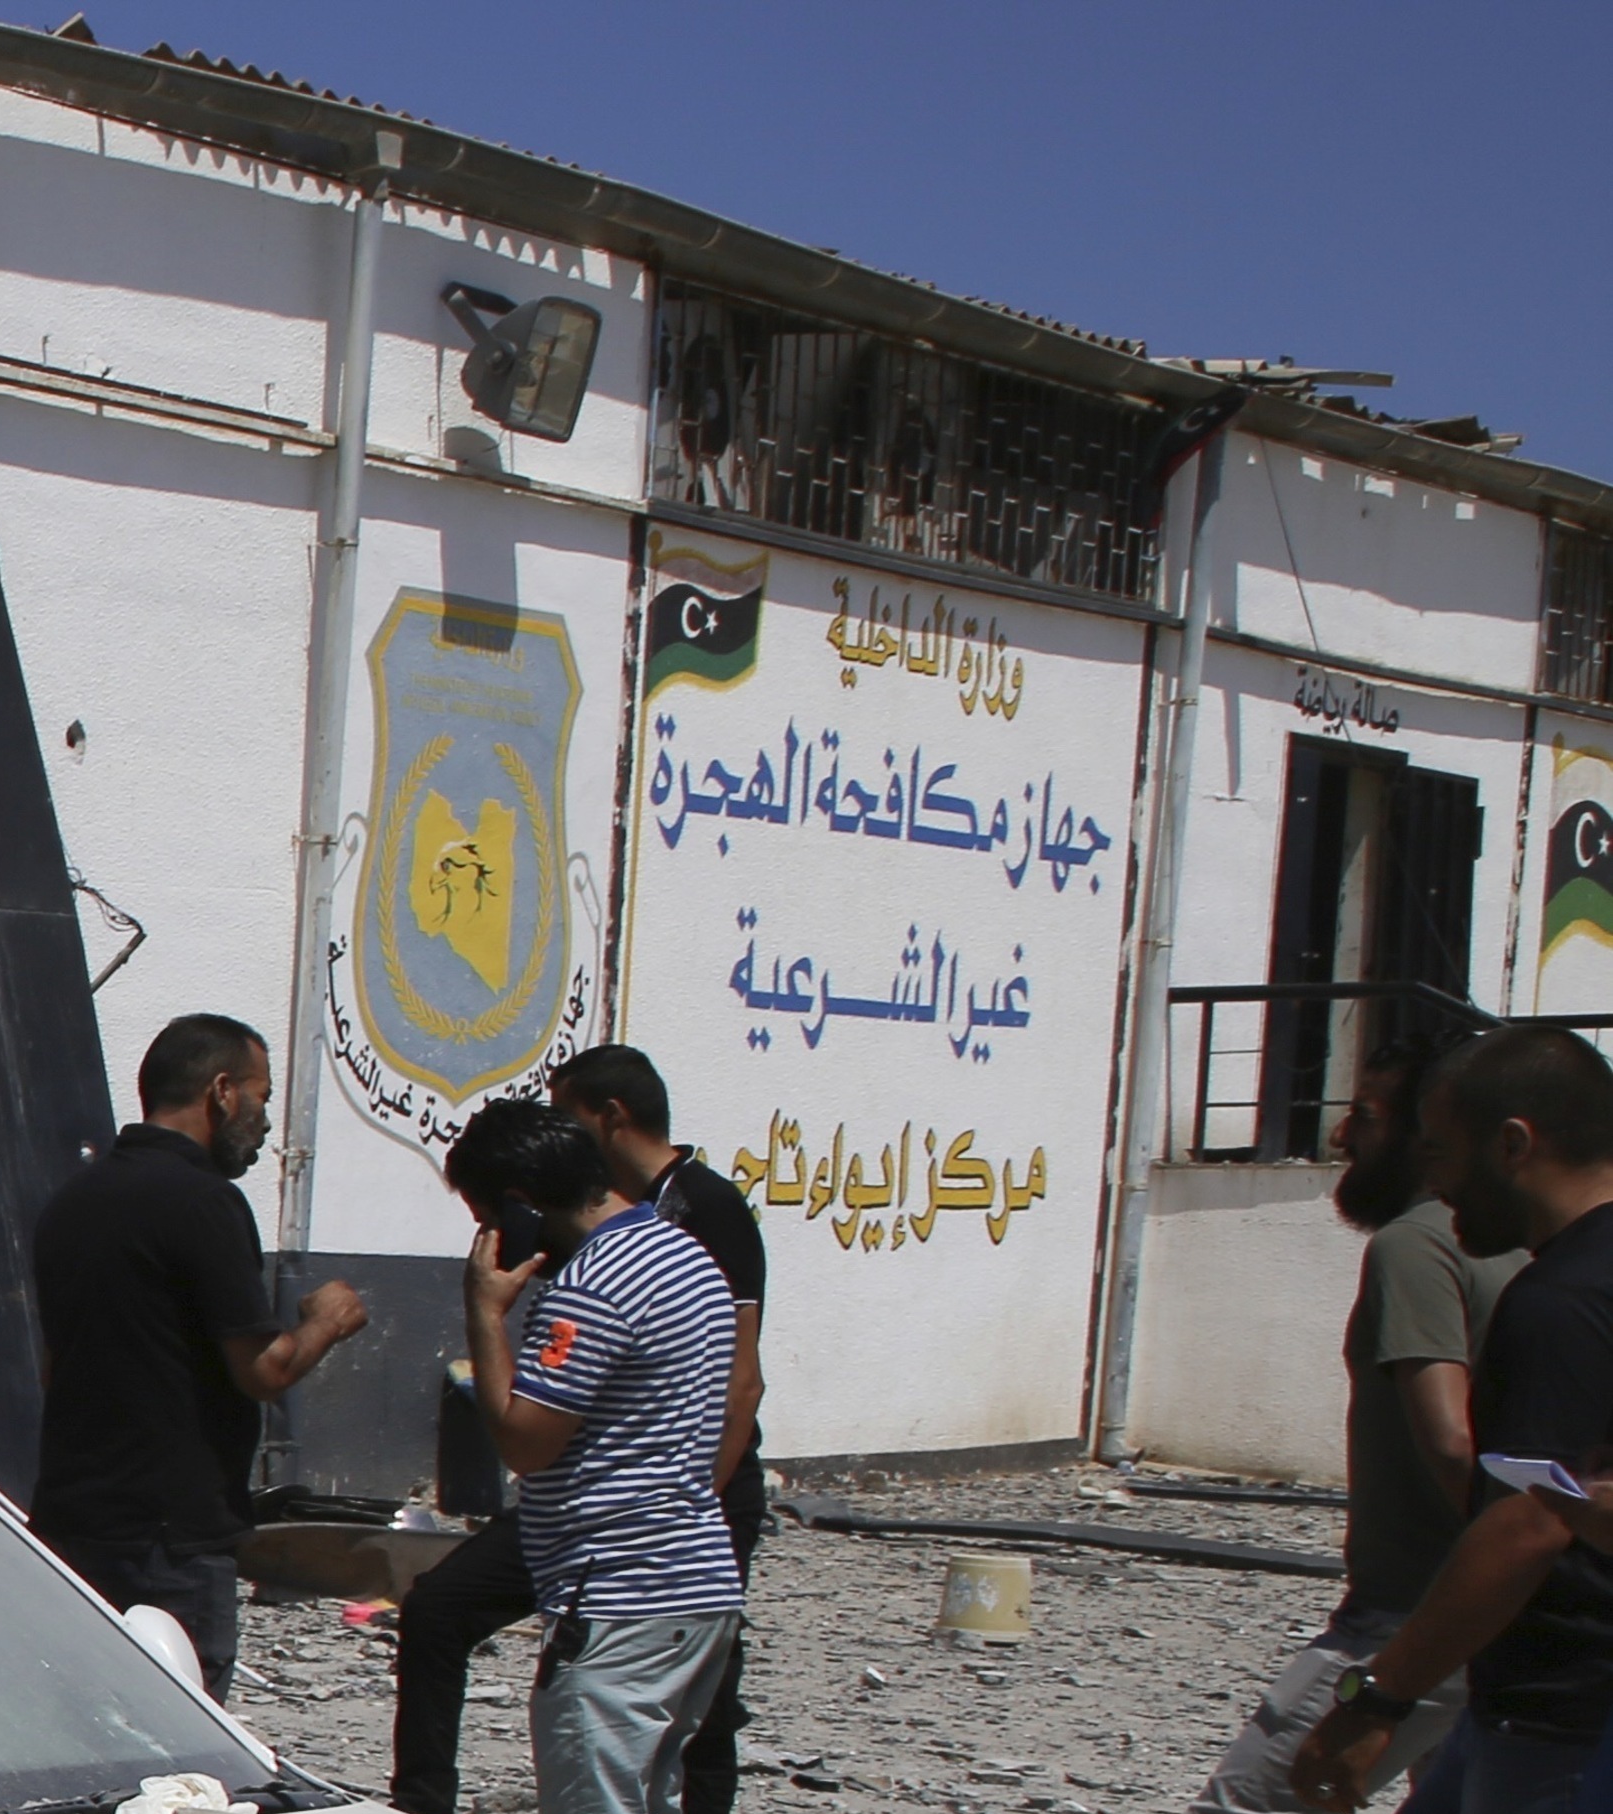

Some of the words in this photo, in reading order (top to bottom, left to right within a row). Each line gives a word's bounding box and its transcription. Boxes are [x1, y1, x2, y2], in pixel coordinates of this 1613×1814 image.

[826, 576, 956, 690] الداخلية
[959, 611, 1025, 721] وزارة
[649, 713, 812, 858] الهجرة
[815, 729, 1009, 853] مكافحة
[1002, 770, 1112, 895] جهاز
[728, 906, 958, 1052] الشرعية
[948, 944, 1031, 1065] غير
[907, 1128, 1048, 1246] مركز
[540, 1320, 578, 1369] 3
